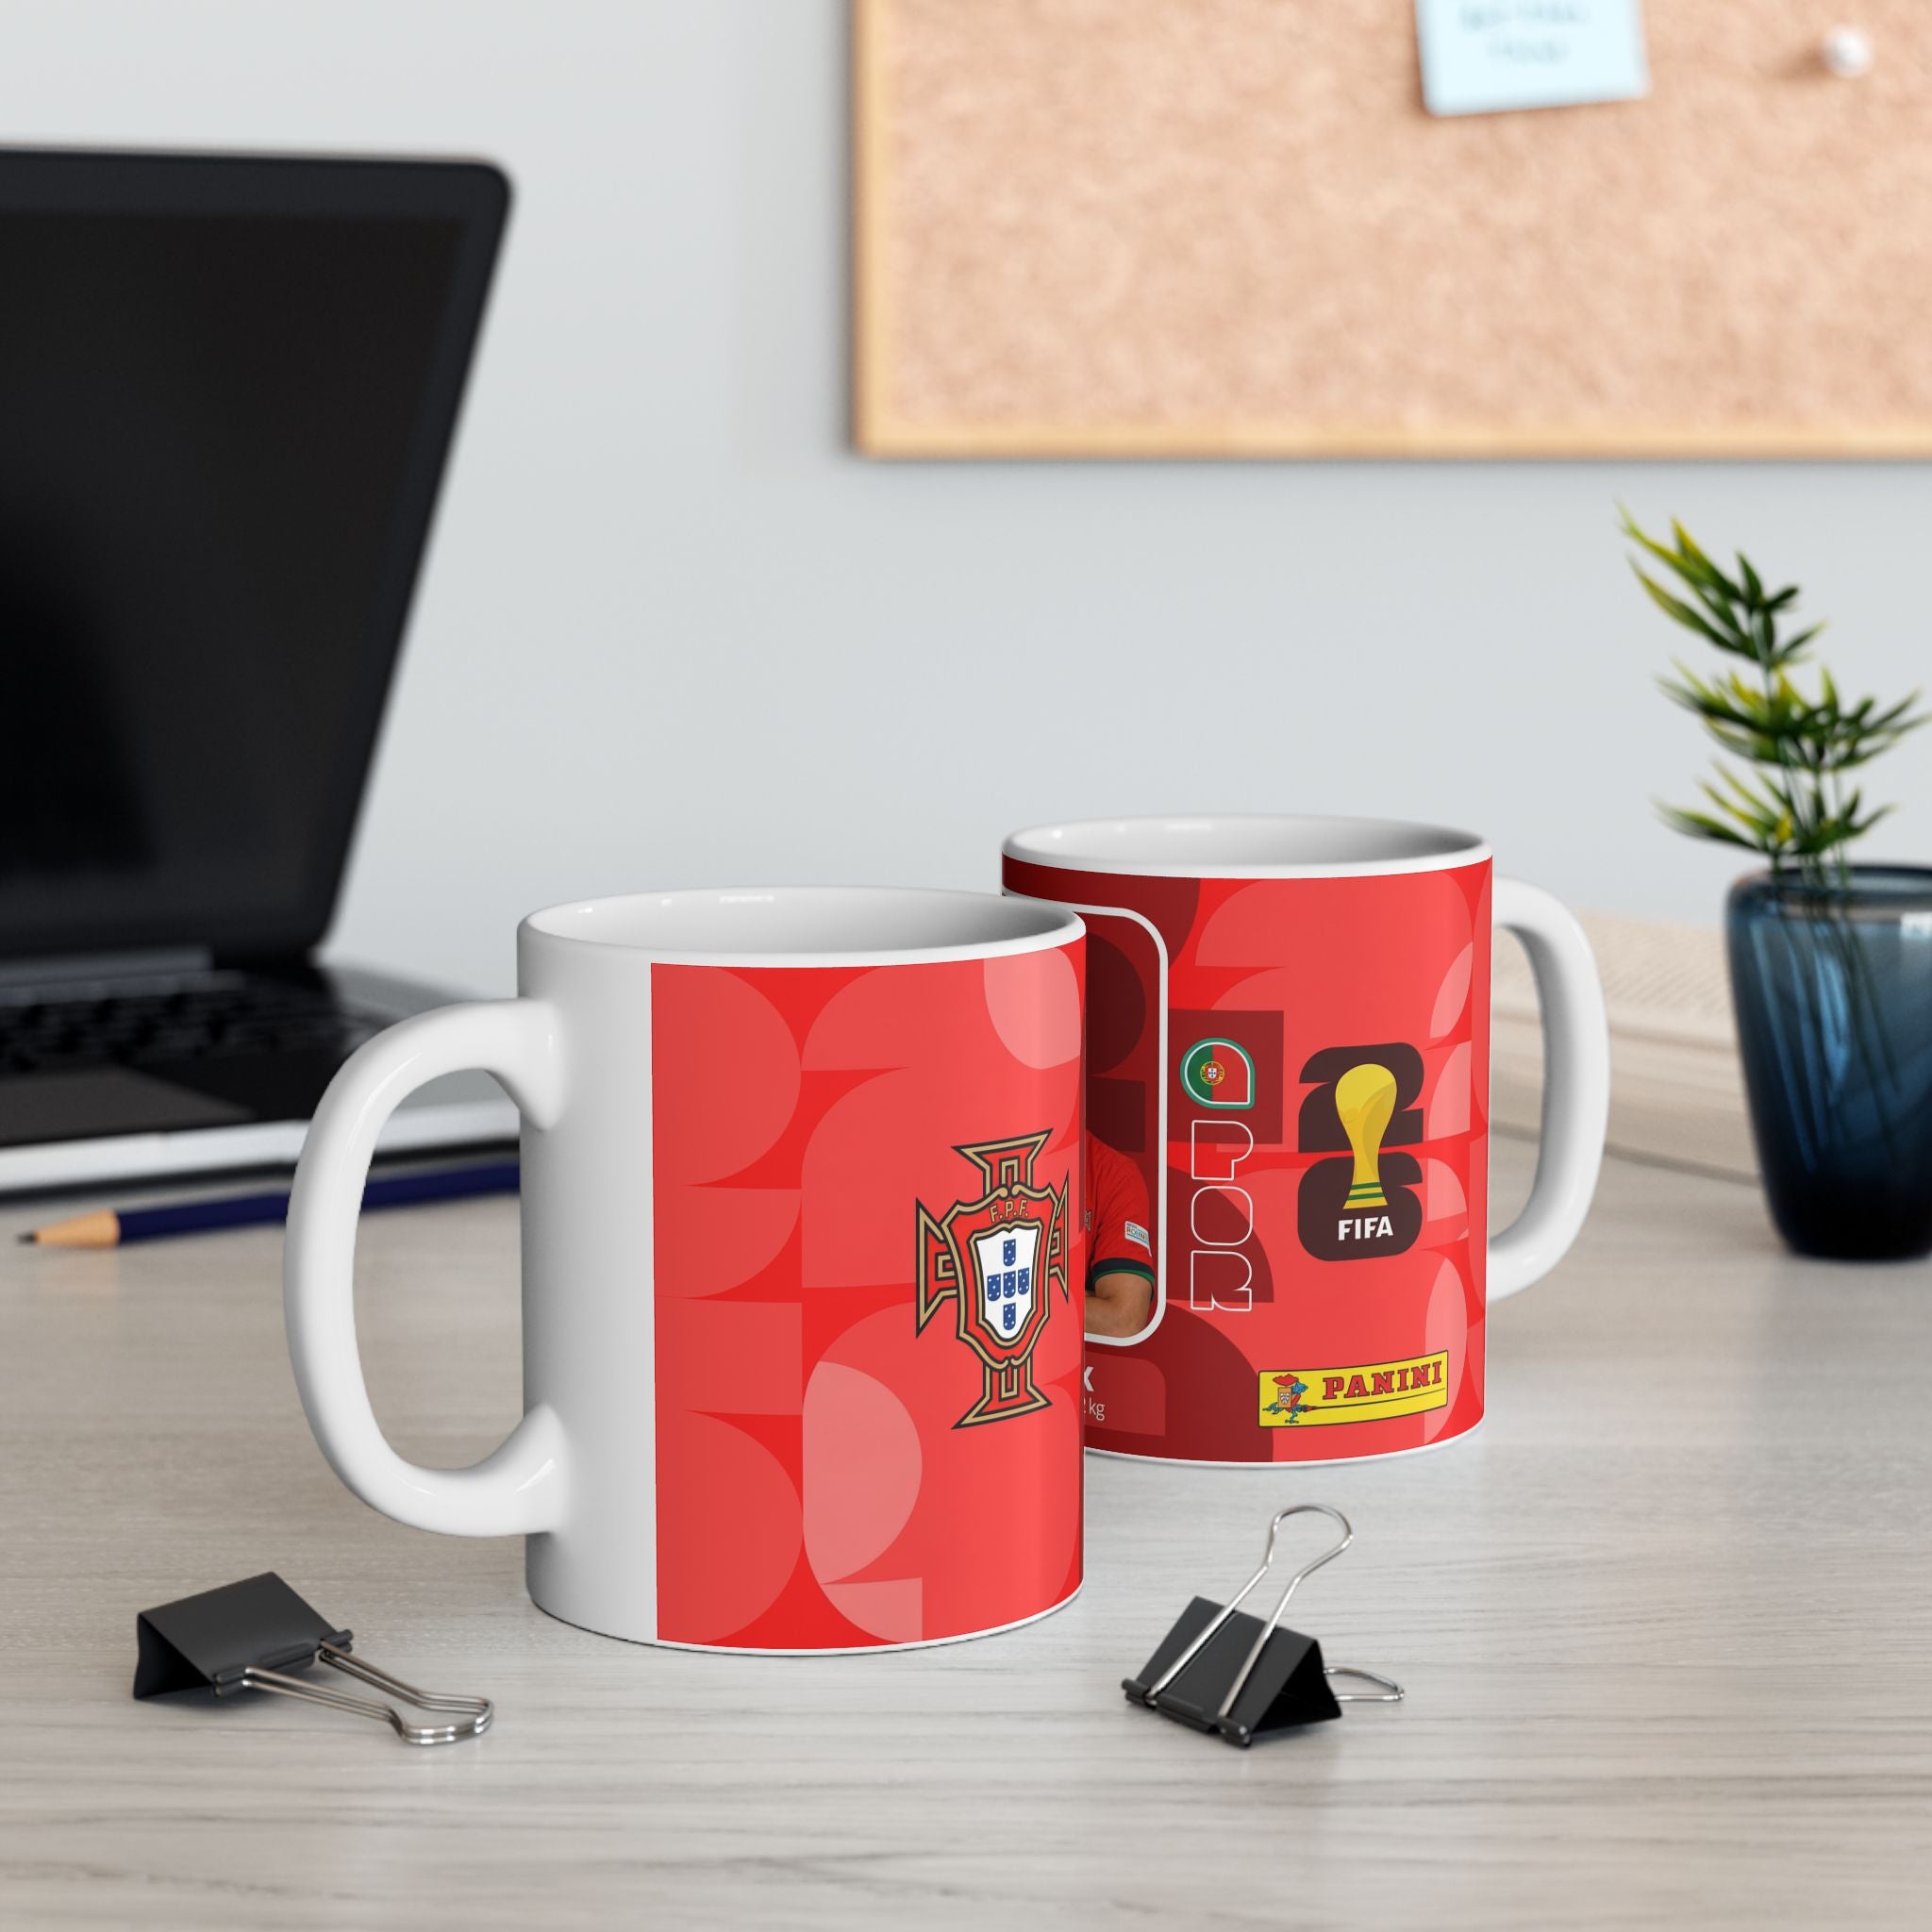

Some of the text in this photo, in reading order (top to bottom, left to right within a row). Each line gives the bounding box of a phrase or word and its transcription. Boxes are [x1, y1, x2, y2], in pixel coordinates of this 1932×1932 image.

[990, 1199, 1028, 1223] F.P.F.
[1191, 1120, 1254, 1312] POR
[1338, 1216, 1393, 1241] FIFA
[1323, 1361, 1441, 1400] PANINI
[1089, 1397, 1106, 1422] kg
